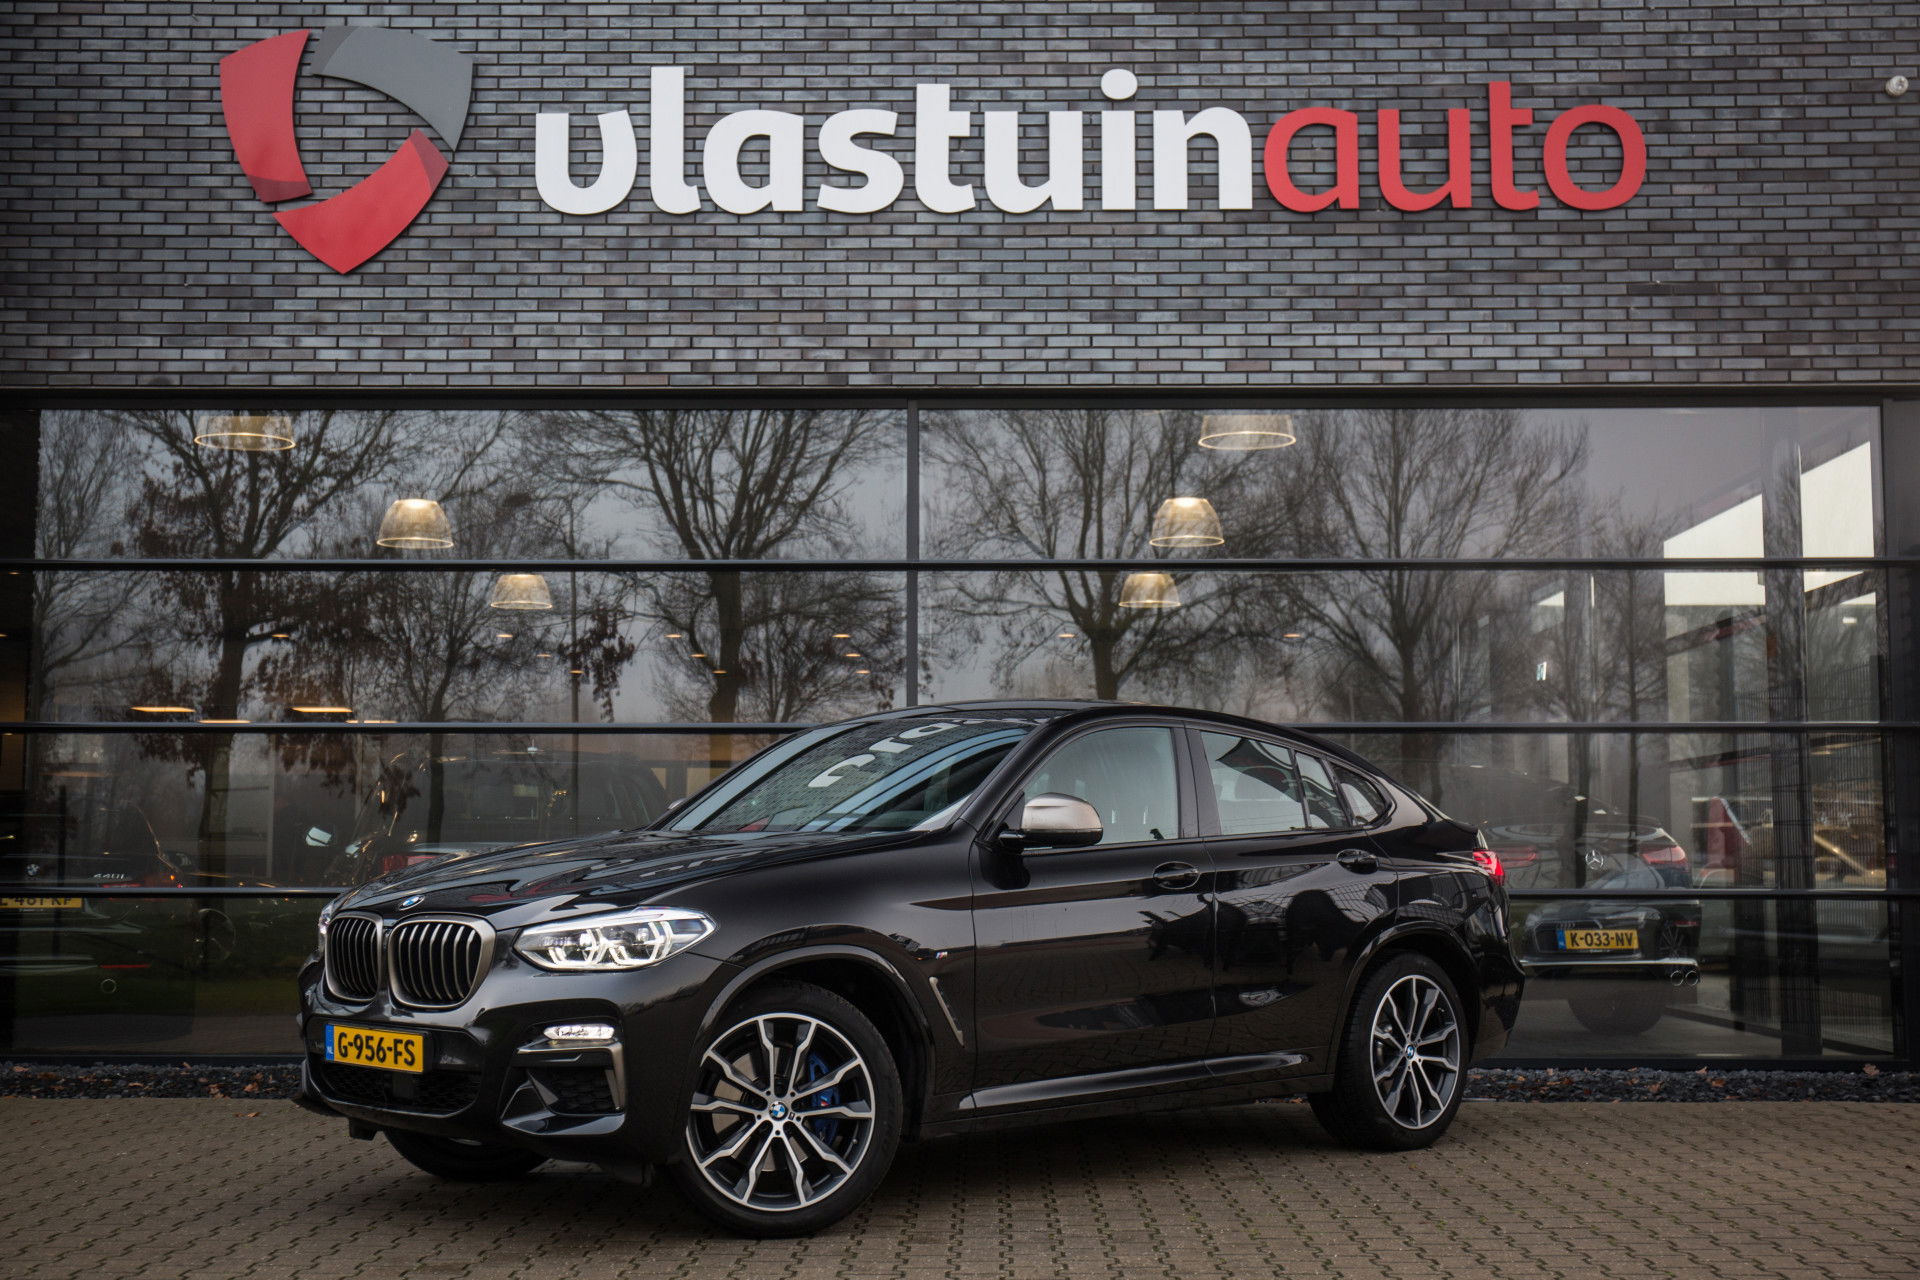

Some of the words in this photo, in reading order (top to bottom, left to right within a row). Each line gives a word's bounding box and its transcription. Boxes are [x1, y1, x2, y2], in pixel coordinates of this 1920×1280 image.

[534, 65, 1647, 215] vlastuinauto
[1569, 932, 1634, 947] K-033-NV
[337, 1031, 416, 1067] G-956-FS
